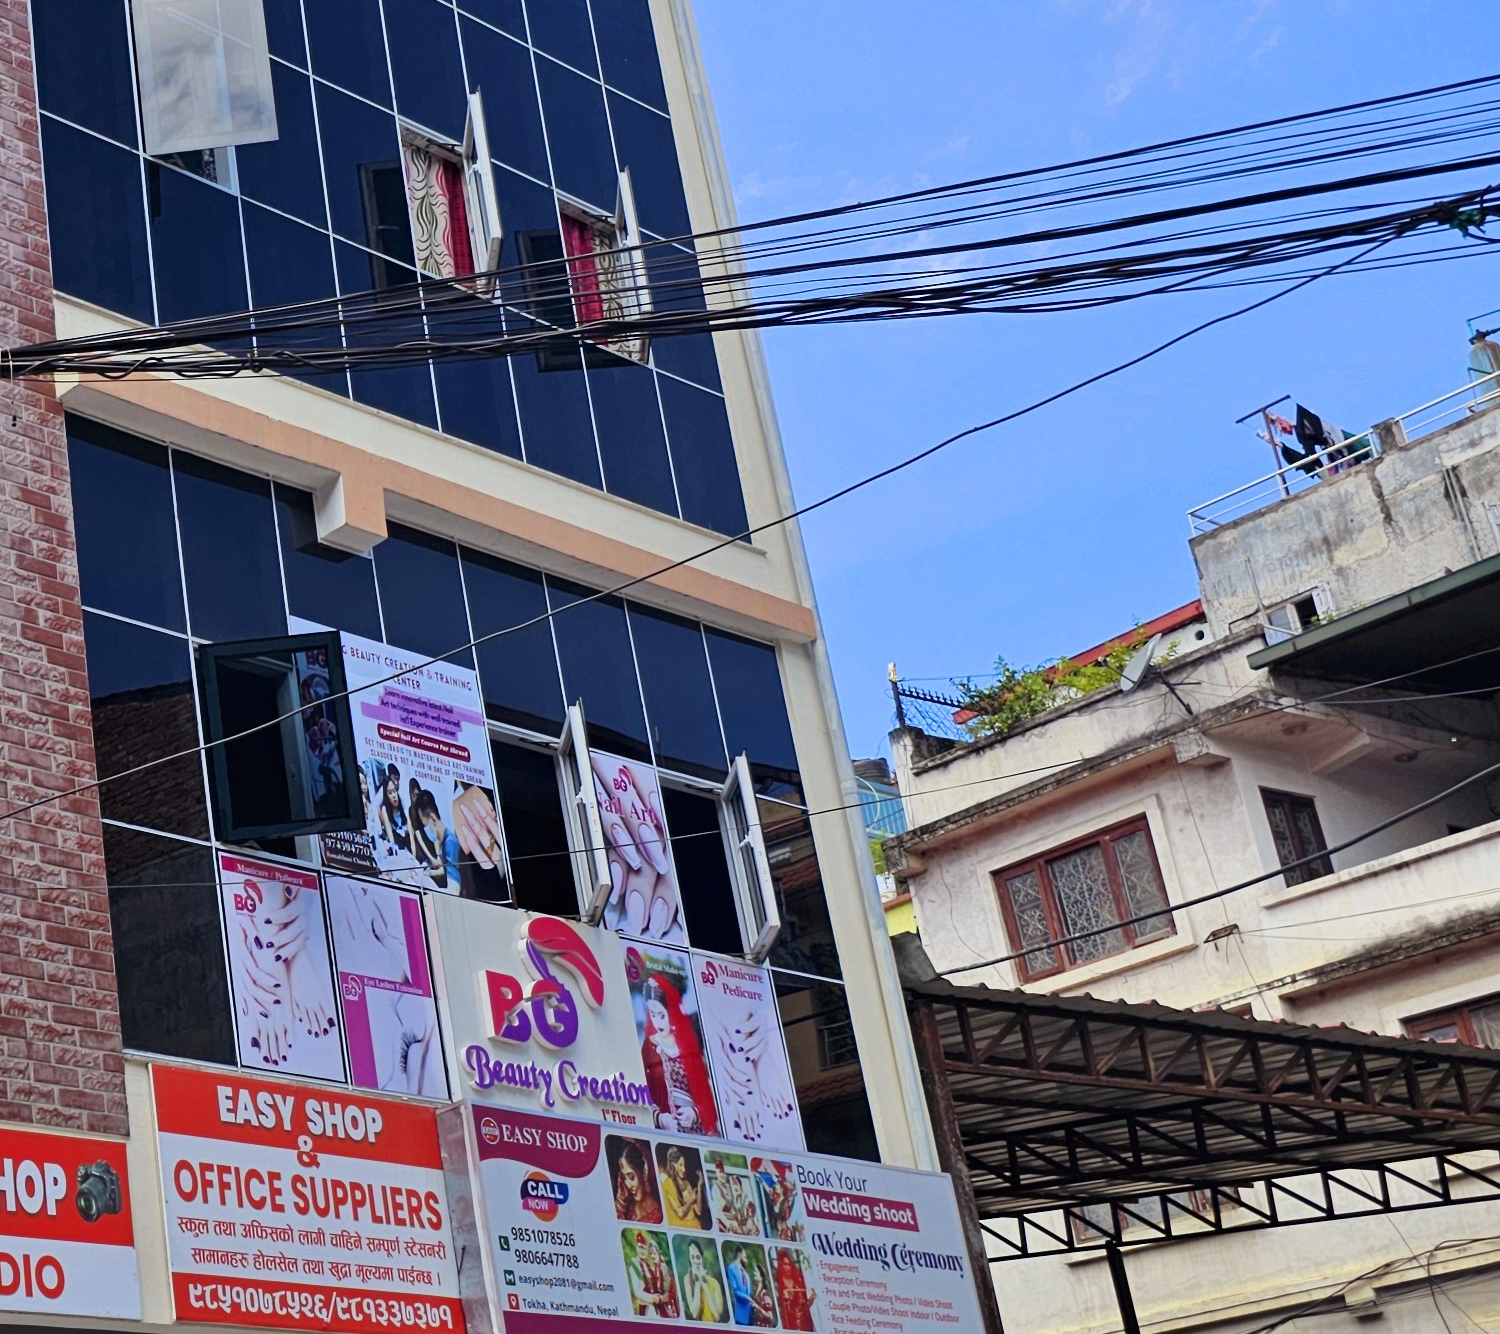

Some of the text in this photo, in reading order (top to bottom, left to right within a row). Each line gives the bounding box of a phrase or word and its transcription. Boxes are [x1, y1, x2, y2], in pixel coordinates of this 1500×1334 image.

[351, 647, 381, 664] BEAUTY
[427, 670, 432, 679] &
[435, 672, 472, 691] TRAINING
[237, 863, 303, 886] Manicure Pedicure
[234, 893, 256, 913] BG
[718, 964, 763, 984] Manicure
[478, 957, 580, 1050] BG
[722, 983, 763, 1001] Pedicure
[460, 1045, 655, 1109] Beauty Creation
[217, 1085, 382, 1142] EASY SHOP
[612, 1109, 636, 1125] Floor
[297, 1135, 320, 1168] &
[501, 1124, 588, 1153] EASY SHOP
[527, 1181, 563, 1199] CALL
[797, 1165, 867, 1192] Book Your
[174, 1159, 442, 1231] OFFICE SUPPLIERS
[528, 1199, 549, 1210] NOW
[804, 1192, 914, 1225] Wedding shoot
[177, 1216, 446, 1259] स्कुल तथा अफिसको लागी चाहिने सम्पूर्ण स्टेसनरी
[511, 1227, 575, 1247] 9851078526
[252, 1249, 299, 1273] होलसेल
[302, 1258, 324, 1275] तथा
[327, 1261, 352, 1281] खुद्रा
[355, 1263, 394, 1283] मूल्यमा
[515, 1249, 579, 1268] 9806647788
[812, 1232, 964, 1279] Wedding Ceremony
[518, 1274, 614, 1292] easyshop2081@gmail.com
[522, 1299, 618, 1318] Tokha, Kathmandu, Nepal
